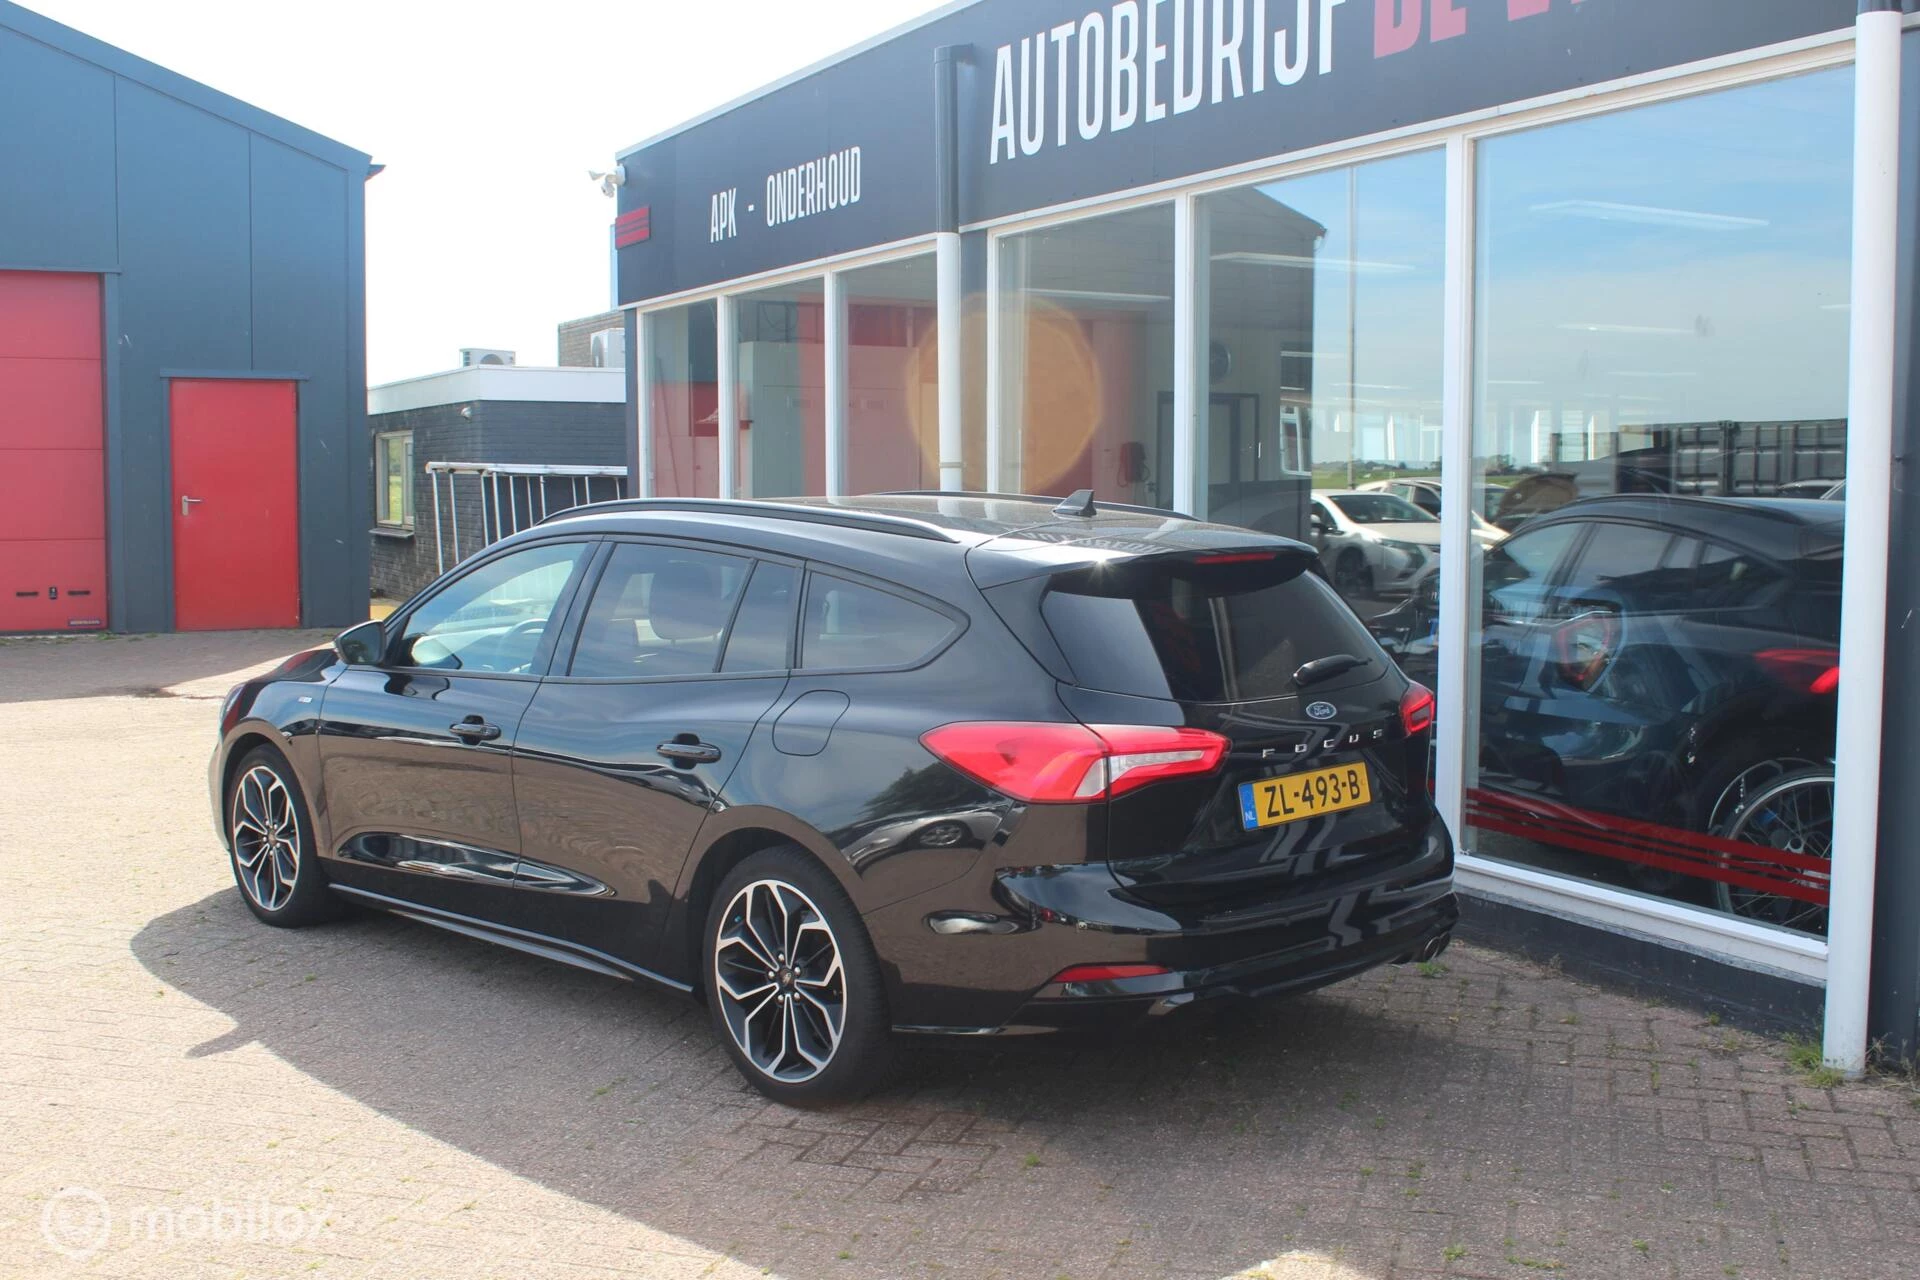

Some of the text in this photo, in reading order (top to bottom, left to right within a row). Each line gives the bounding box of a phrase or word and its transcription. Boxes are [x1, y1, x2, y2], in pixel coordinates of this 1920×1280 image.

[710, 187, 737, 243] APK
[766, 146, 861, 227] ONDERHOUD
[1262, 728, 1383, 759] FOCUS
[1264, 769, 1361, 818] ZL-493-B
[1244, 810, 1257, 822] NL
